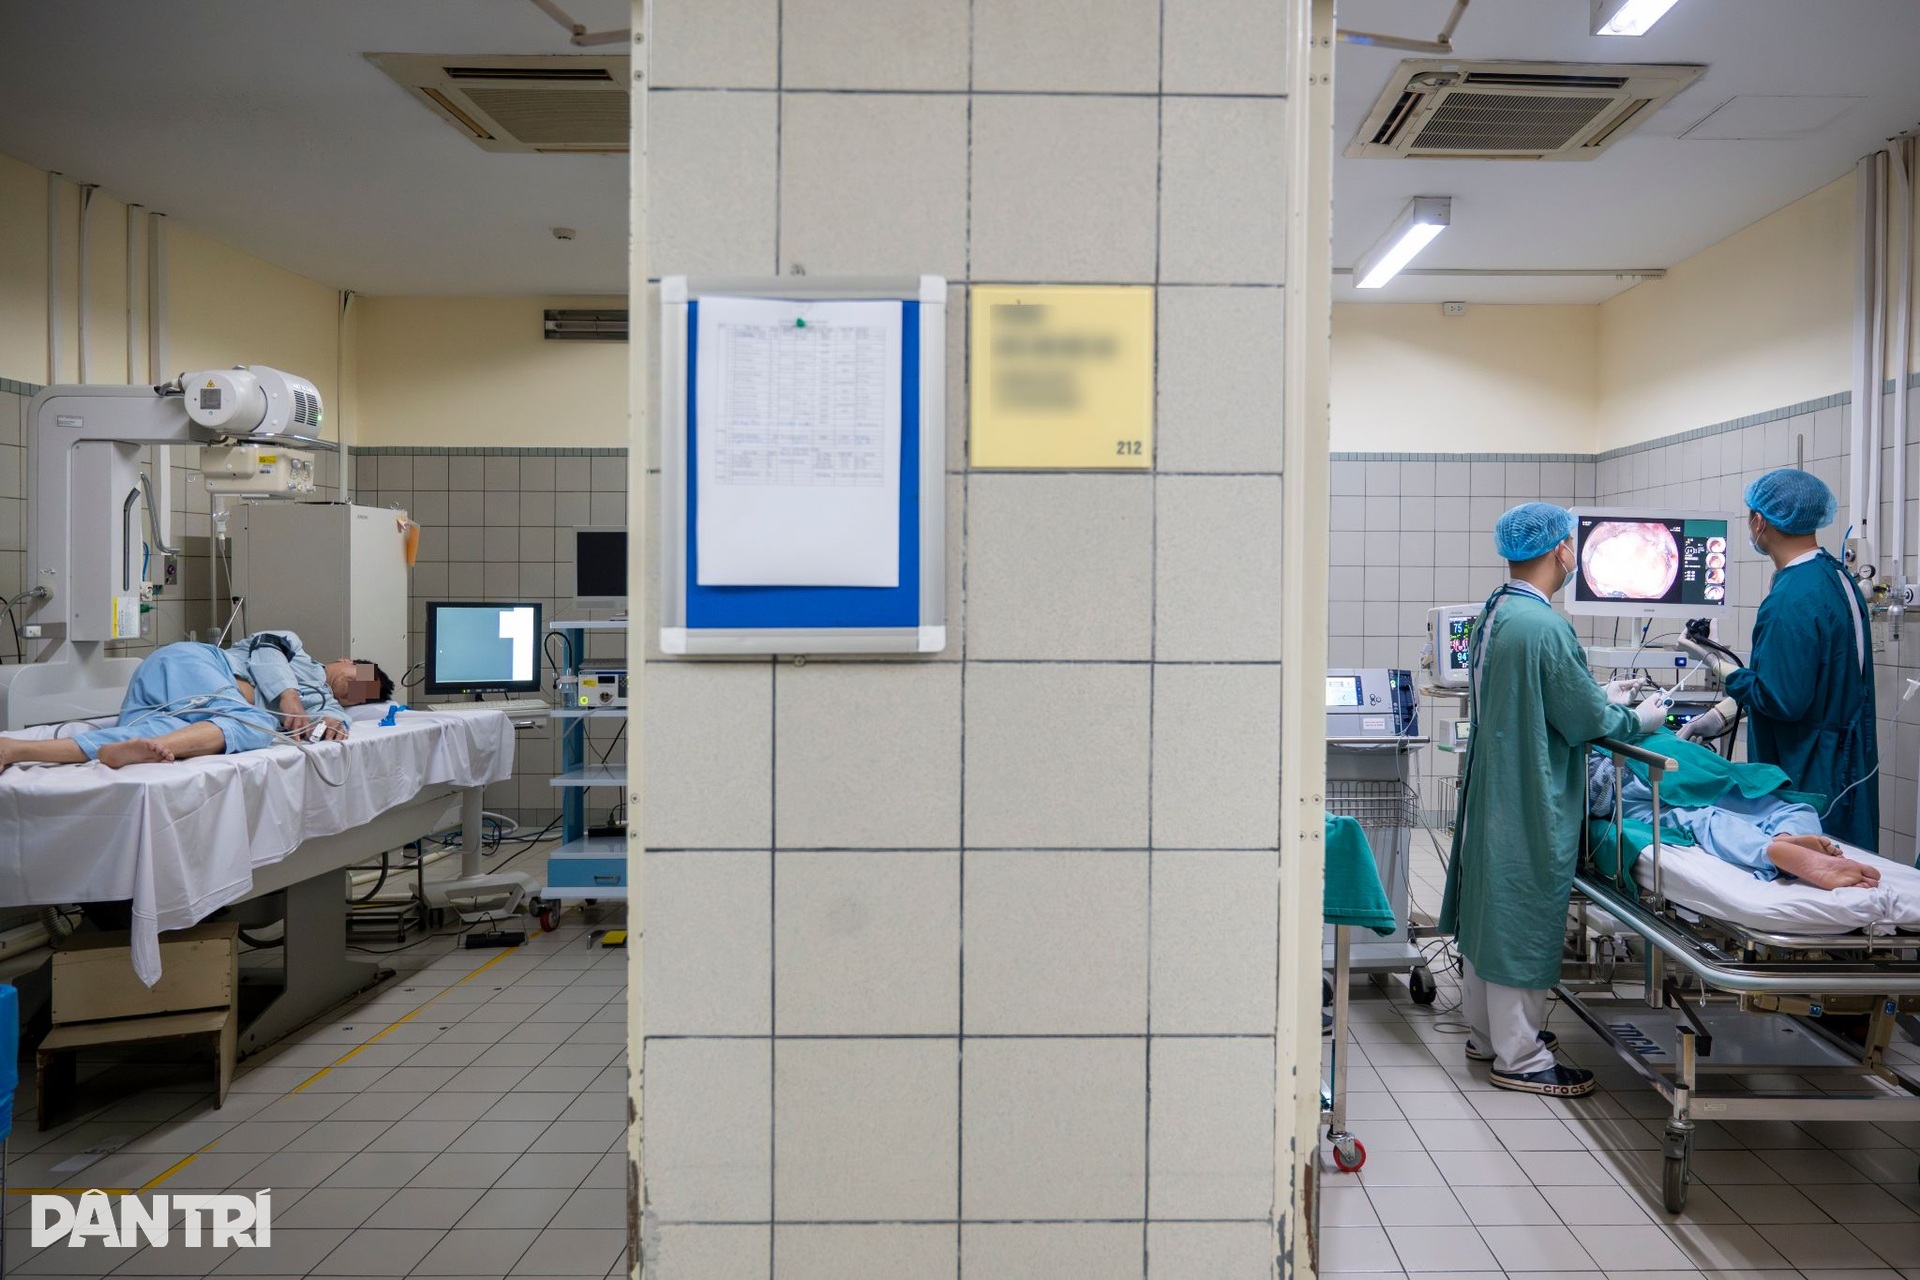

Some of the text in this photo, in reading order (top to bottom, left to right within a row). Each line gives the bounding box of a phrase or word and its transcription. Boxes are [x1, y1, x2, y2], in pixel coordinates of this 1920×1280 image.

[1117, 440, 1142, 455] 212
[1453, 623, 1463, 634] 75
[1543, 1085, 1586, 1094] crocs
